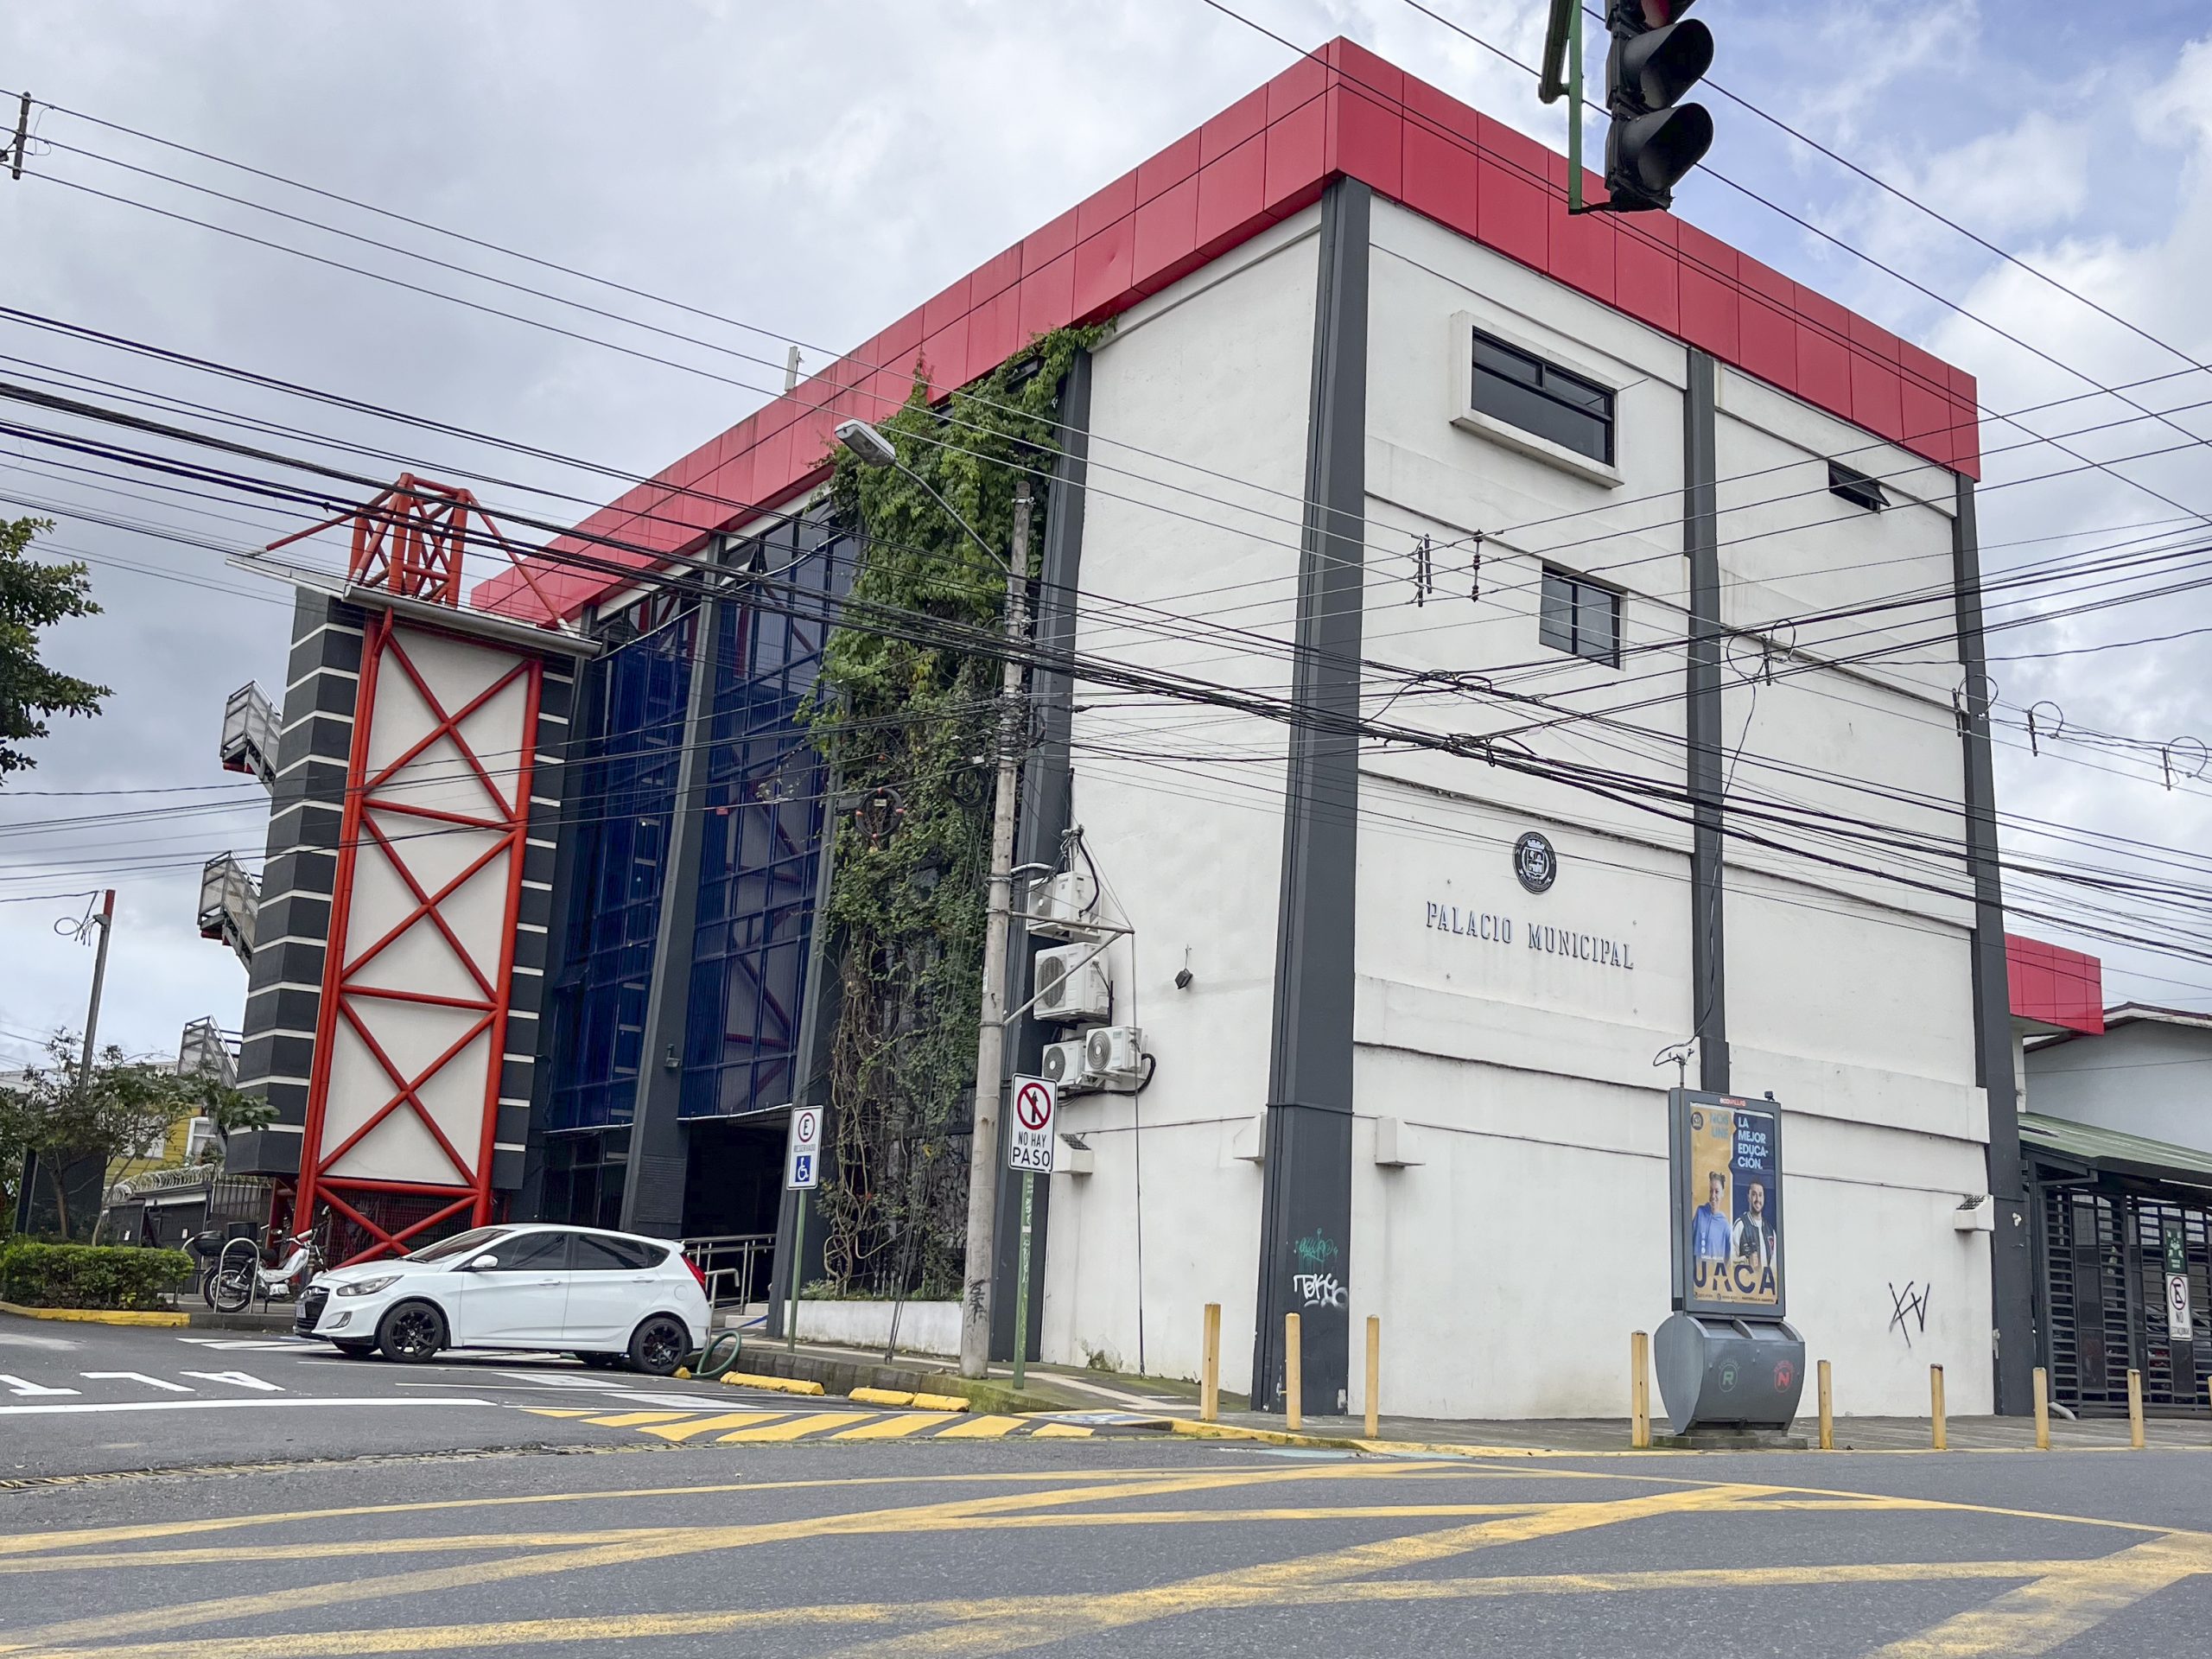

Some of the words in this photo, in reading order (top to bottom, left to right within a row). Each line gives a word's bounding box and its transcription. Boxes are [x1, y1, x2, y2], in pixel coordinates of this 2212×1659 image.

[1426, 900, 1513, 944] PALACIO
[1528, 922, 1634, 969] MUNICIPAL
[803, 1119, 810, 1136] E
[1738, 1116, 1749, 1128] LA
[1018, 1130, 1028, 1147] NO
[1031, 1133, 1046, 1148] HAY
[1738, 1129, 1766, 1144] MEJOR
[1013, 1147, 1050, 1166] PASO
[1738, 1142, 1768, 1157] EDUCA-
[1694, 1255, 1776, 1295] UACA
[0, 1371, 286, 1396] ALT
